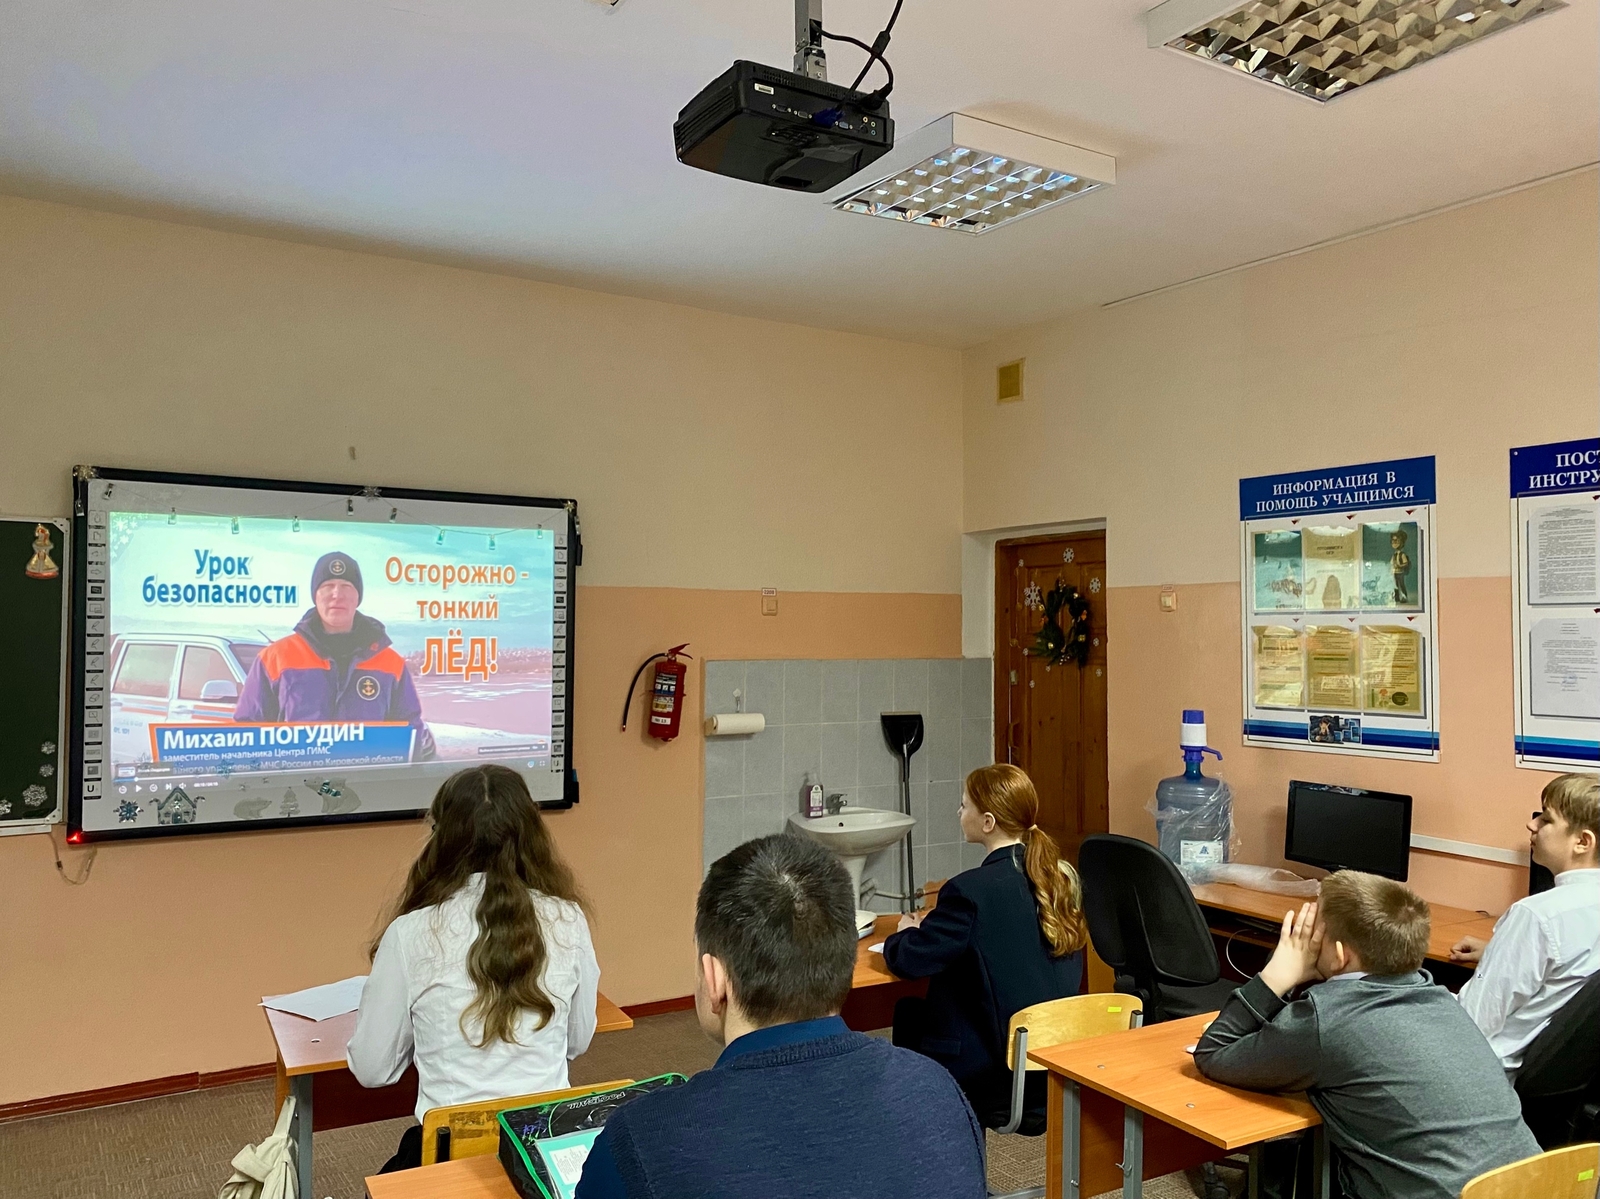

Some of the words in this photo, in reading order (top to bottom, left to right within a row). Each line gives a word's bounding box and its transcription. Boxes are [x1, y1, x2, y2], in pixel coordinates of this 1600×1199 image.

[1272, 473, 1379, 496] ИНФОРМАЦИЯ
[1385, 471, 1397, 484] В
[1256, 496, 1318, 513] ПОМОЩЬ
[1322, 486, 1415, 507] УЧАЩИМСЯ
[194, 549, 250, 582] Урок
[385, 556, 516, 590] Осторожно
[142, 575, 297, 605] безопасности
[416, 593, 499, 620] тонкий
[420, 628, 498, 681] ЛЁД!
[163, 730, 254, 750] Михаил
[260, 722, 364, 746] ПОГУДИН
[162, 753, 220, 763] заместитель
[221, 750, 272, 759] начальника
[274, 749, 305, 758] Центра
[307, 746, 331, 755] ГИМС
[281, 759, 311, 769] России
[325, 756, 369, 766] Кировской
[371, 754, 404, 763] области
